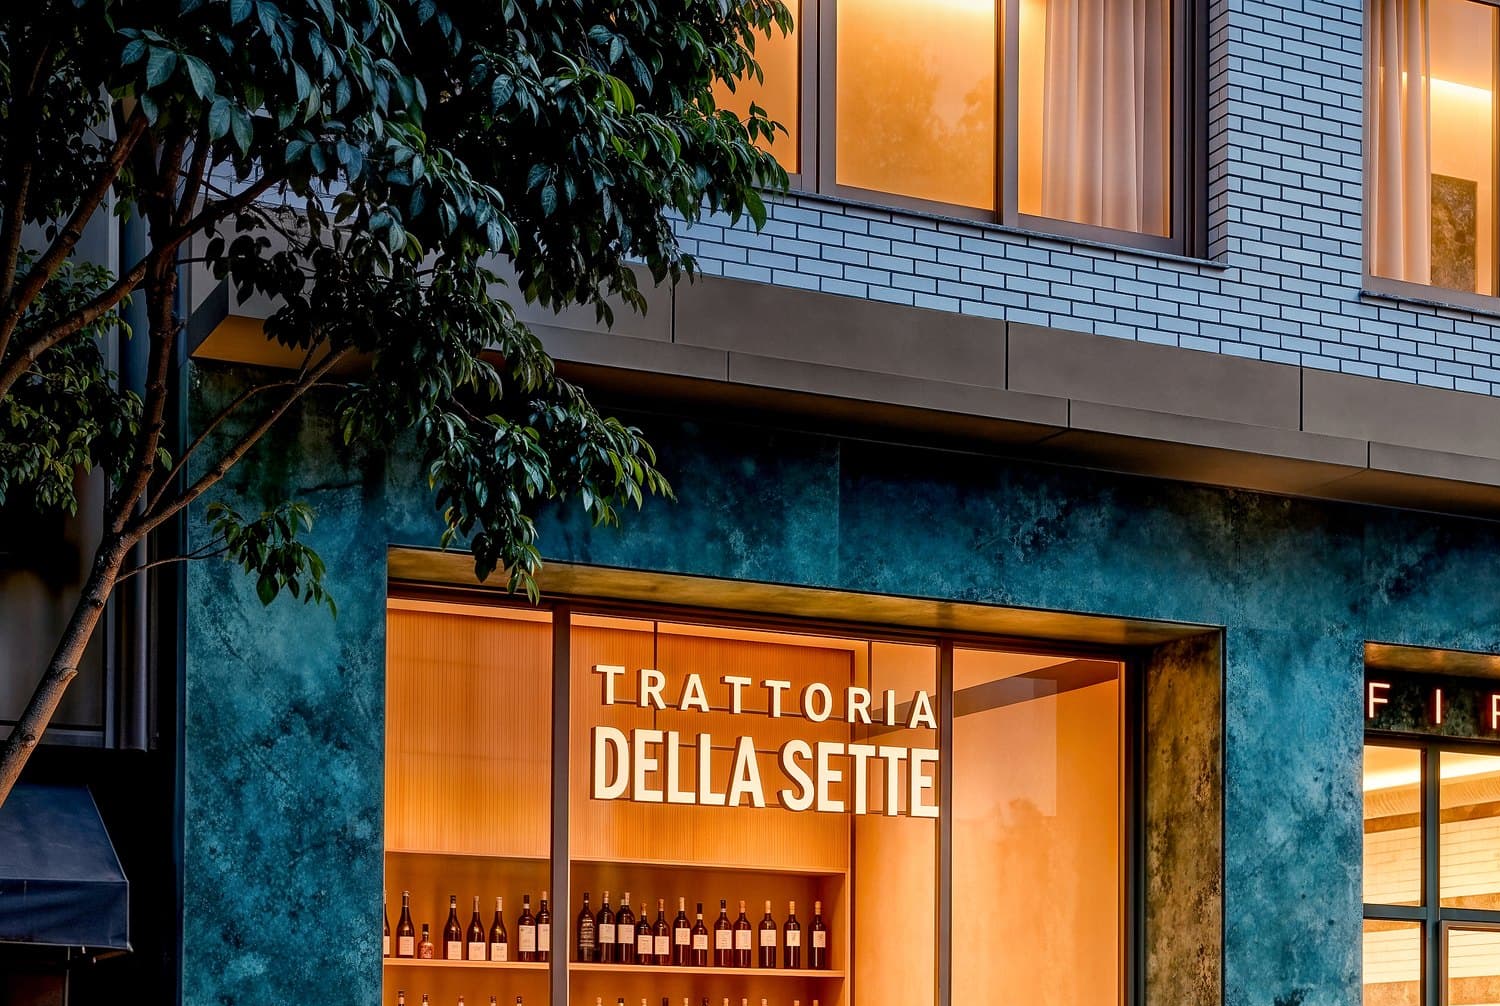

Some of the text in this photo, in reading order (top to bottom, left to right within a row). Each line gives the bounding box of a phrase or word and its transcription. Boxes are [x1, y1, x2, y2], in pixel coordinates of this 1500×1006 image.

[594, 664, 938, 729] TRATTORIA
[593, 725, 940, 818] DELLA SETTE
